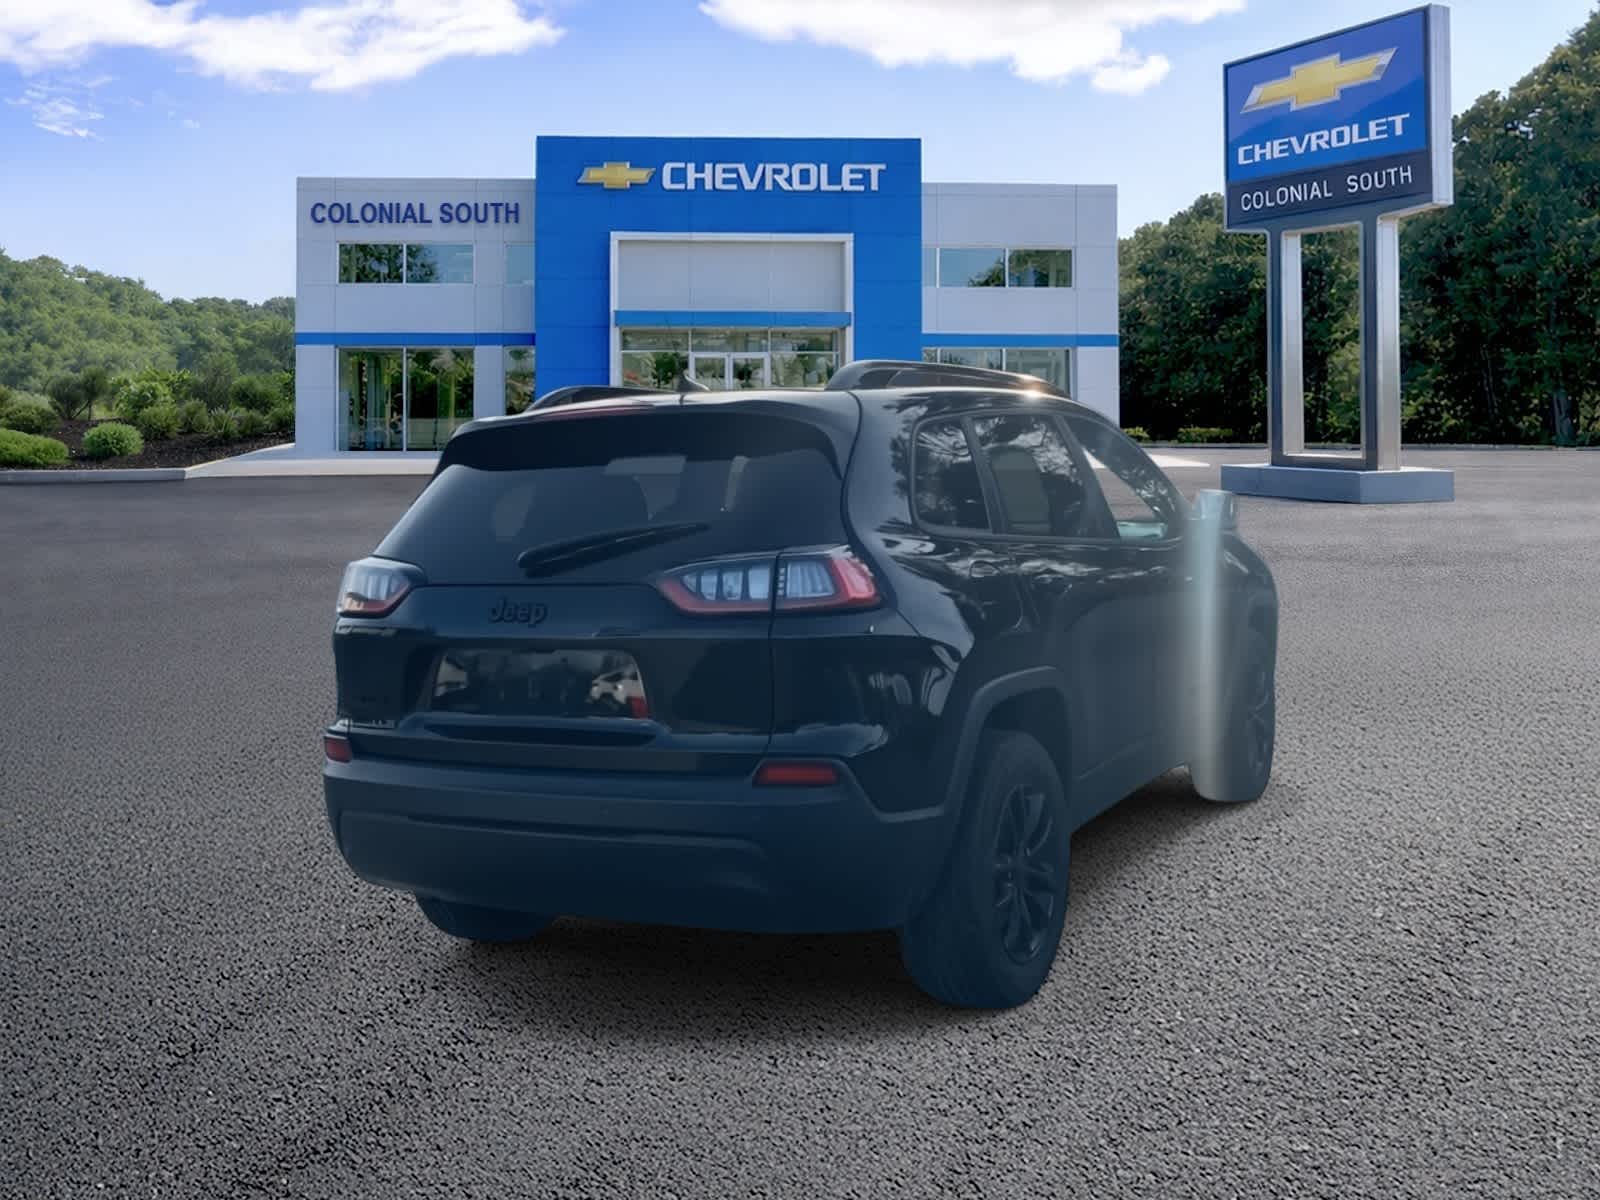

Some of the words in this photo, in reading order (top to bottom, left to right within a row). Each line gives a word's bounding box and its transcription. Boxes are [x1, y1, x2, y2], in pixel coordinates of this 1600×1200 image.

[1238, 113, 1410, 165] CHEVROLET
[661, 162, 887, 192] CHEVROLET
[1240, 180, 1333, 211] COLONIAL
[1347, 165, 1413, 193] SOUTH
[310, 202, 433, 224] COLONIAL
[438, 202, 520, 225] SOUTH
[488, 597, 547, 626] Jeep
